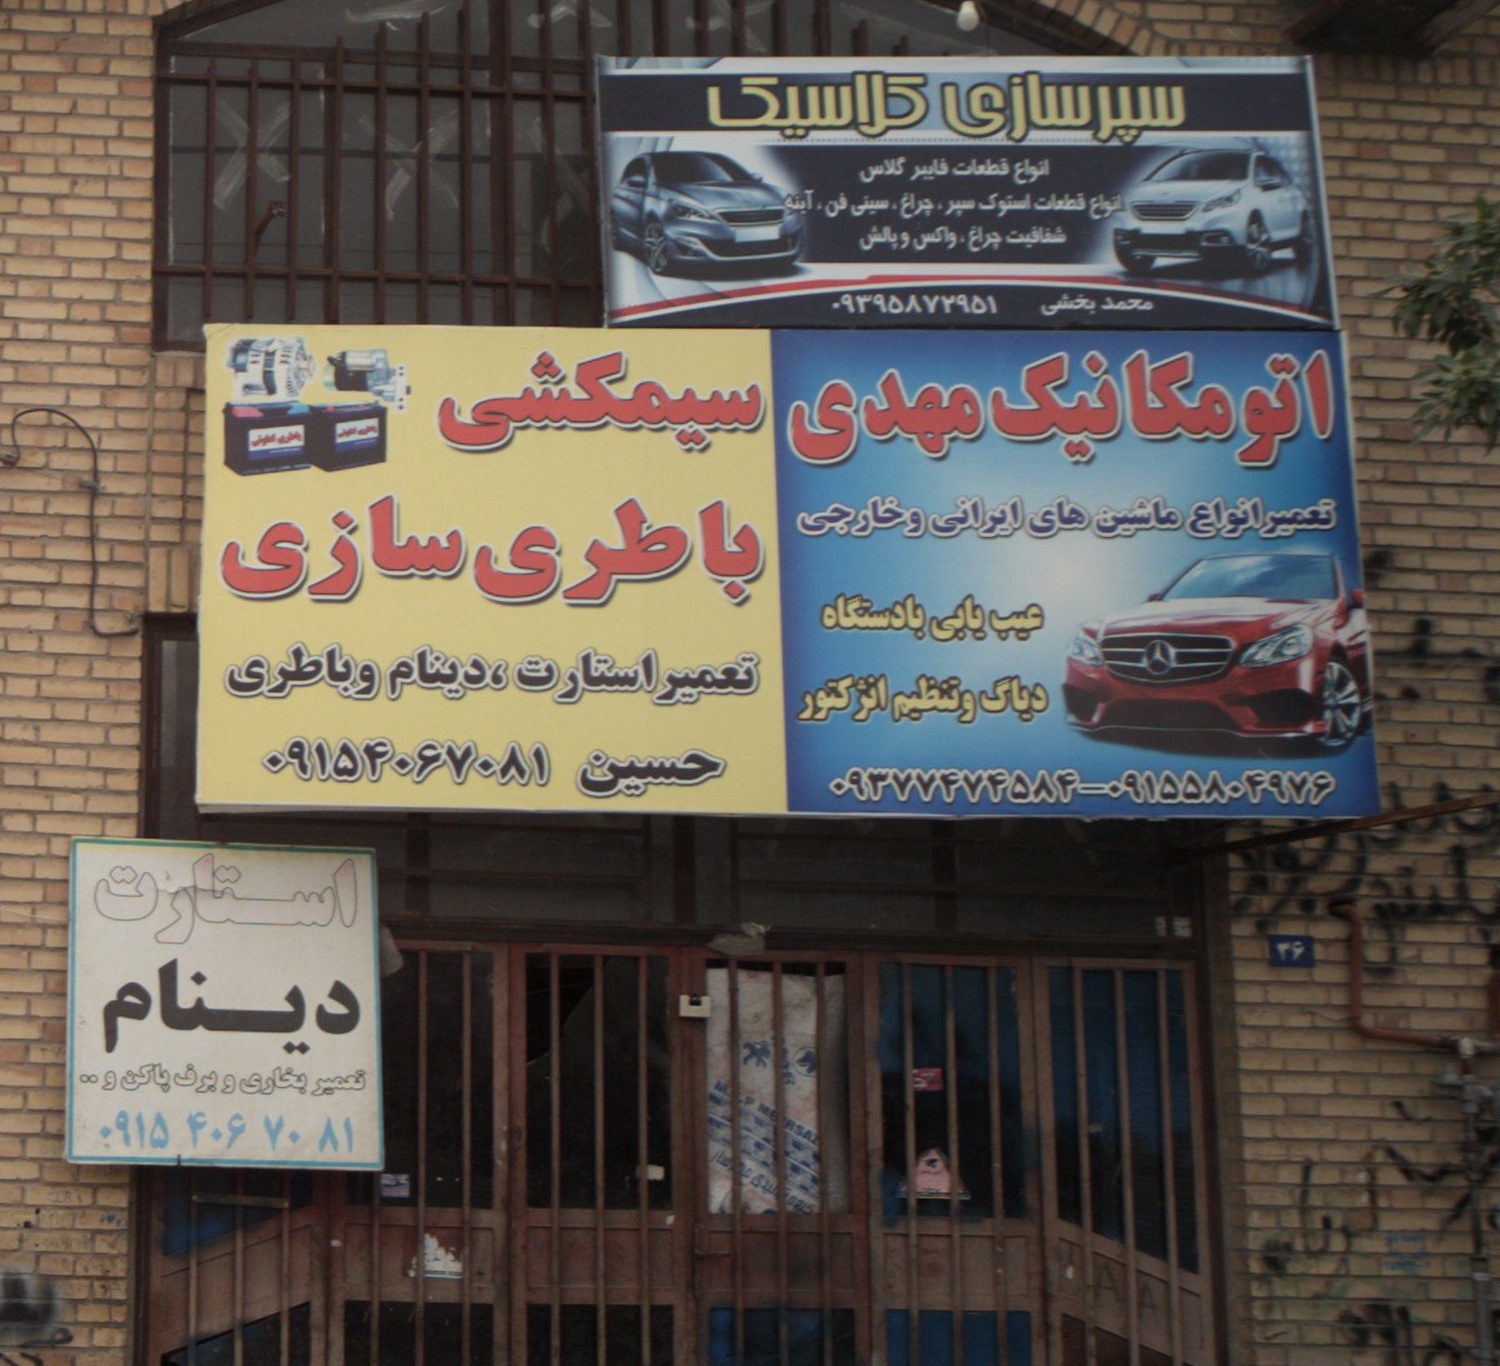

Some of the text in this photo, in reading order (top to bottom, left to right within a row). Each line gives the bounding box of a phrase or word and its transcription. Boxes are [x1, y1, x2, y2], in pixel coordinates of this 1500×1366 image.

[859, 156, 1051, 184] انواع قطعات فایبر گلاس
[824, 193, 849, 217] فن
[850, 194, 890, 217] سینی
[978, 192, 1031, 219] استوک
[1034, 192, 1087, 212] قطعات
[1088, 193, 1125, 220] انواع
[912, 226, 957, 251] واکس
[967, 226, 1003, 252] چراغ
[1005, 225, 1068, 247] شفافیت
[1040, 292, 1097, 317] بخشی
[1101, 295, 1155, 312] محمد
[437, 348, 766, 453] سیمکشی
[789, 368, 984, 464] مهدی
[928, 495, 1024, 539] ایرانی
[1026, 495, 1089, 539] های
[1092, 495, 1182, 538] ماشین
[220, 494, 766, 605] باطری سازی
[929, 593, 987, 642] یابی
[989, 603, 1046, 641] عیب
[796, 673, 889, 723] انژکتور
[978, 674, 1050, 722] دیاگ
[261, 735, 728, 798] حسین ۰۹۱۵۴۰۶۷۰۸۱
[94, 852, 358, 945] استارت
[1276, 940, 1306, 962] ۳۶
[103, 957, 361, 1055] دینام
[119, 1062, 171, 1094] پاکن
[174, 1062, 219, 1094] برف
[221, 1073, 237, 1095] و
[239, 1066, 308, 1096] بخاری
[310, 1069, 367, 1097] تعمیر
[99, 1109, 170, 1149] ۰۹۱۵
[186, 1110, 248, 1150] ۴۰۶
